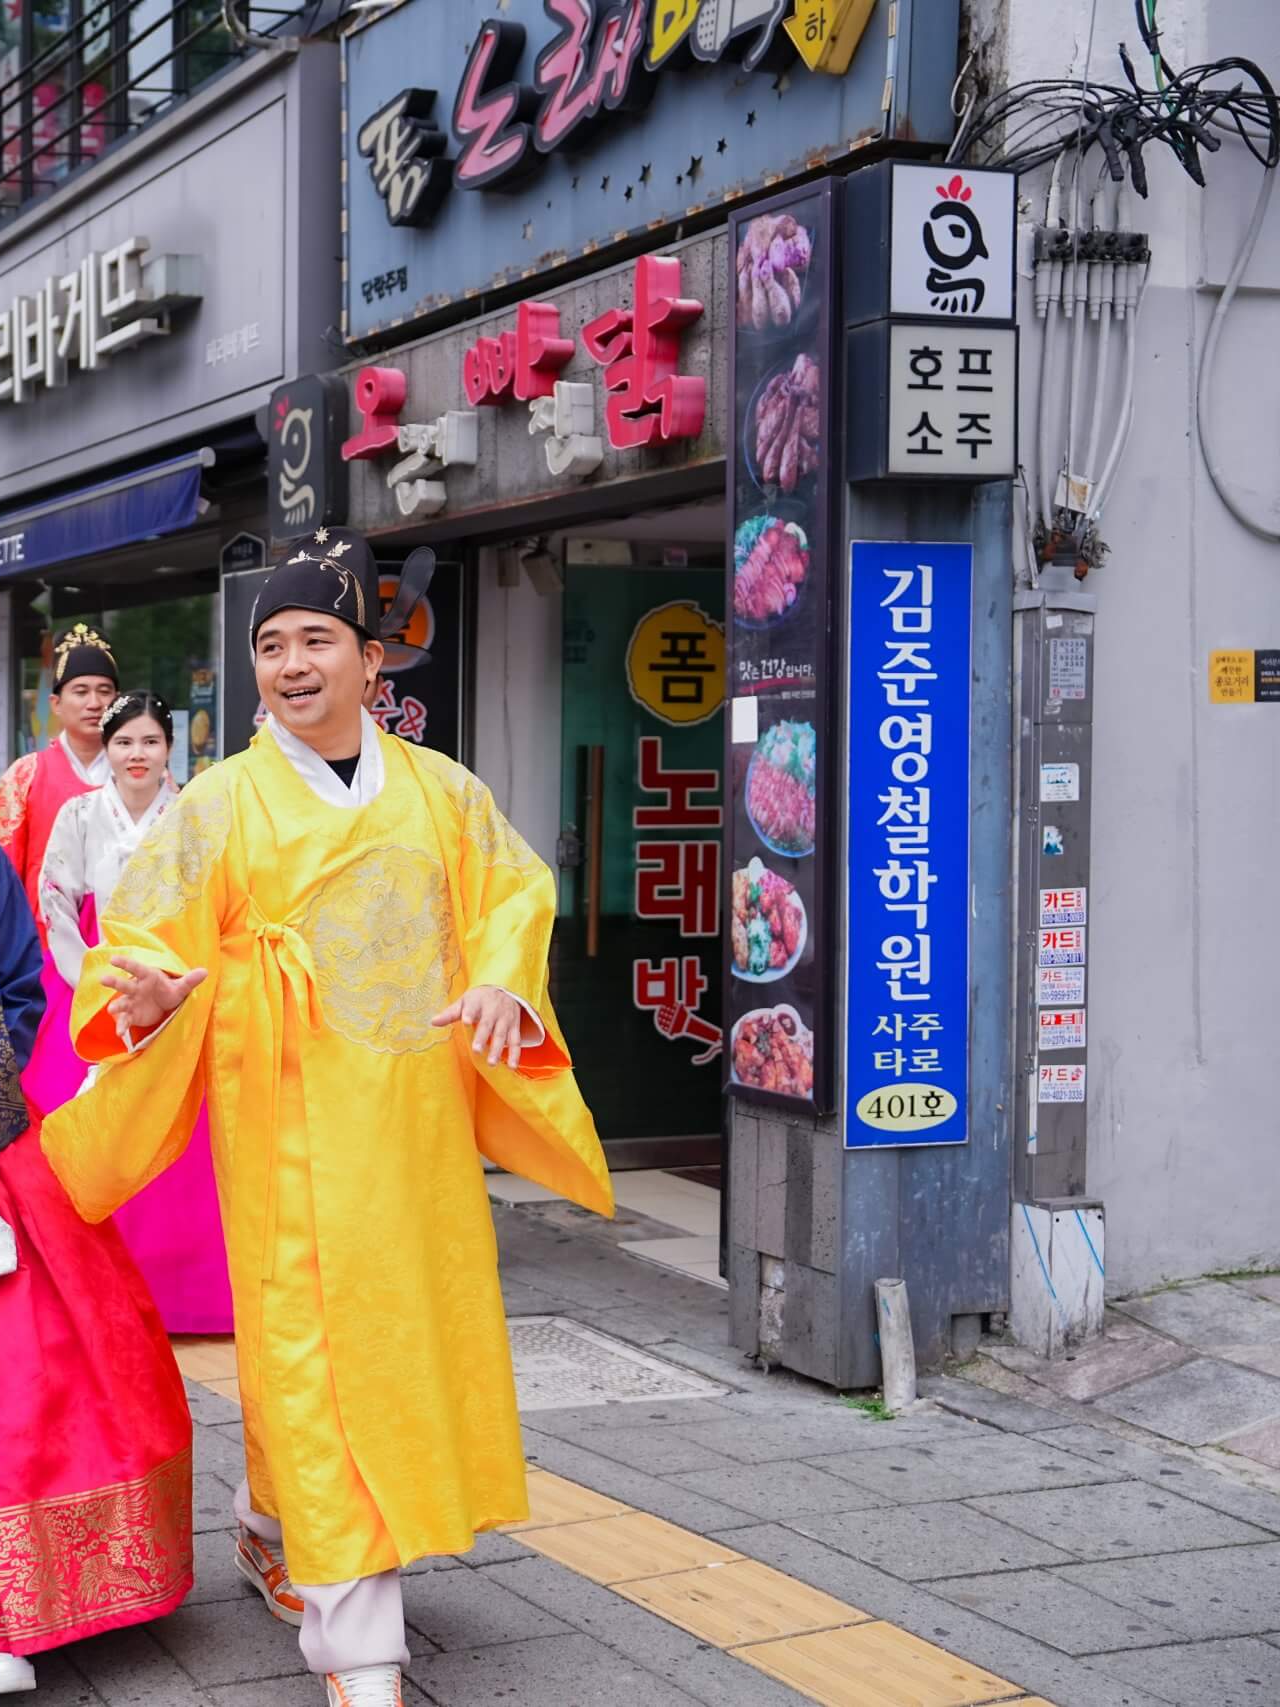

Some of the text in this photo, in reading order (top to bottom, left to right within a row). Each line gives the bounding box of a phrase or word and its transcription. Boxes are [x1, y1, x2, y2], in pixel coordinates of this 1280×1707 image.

[358, 90, 442, 226] 폼
[582, 255, 705, 450] 닭
[907, 345, 993, 393] 호프
[906, 411, 993, 460] 소주
[648, 631, 716, 704] 폼
[1044, 892, 1075, 909] 카드
[1042, 931, 1074, 949] 카드
[1041, 970, 1063, 982] 카드
[872, 1012, 944, 1042] 사주
[873, 1048, 944, 1075] 타로
[866, 1090, 946, 1120] 401호
